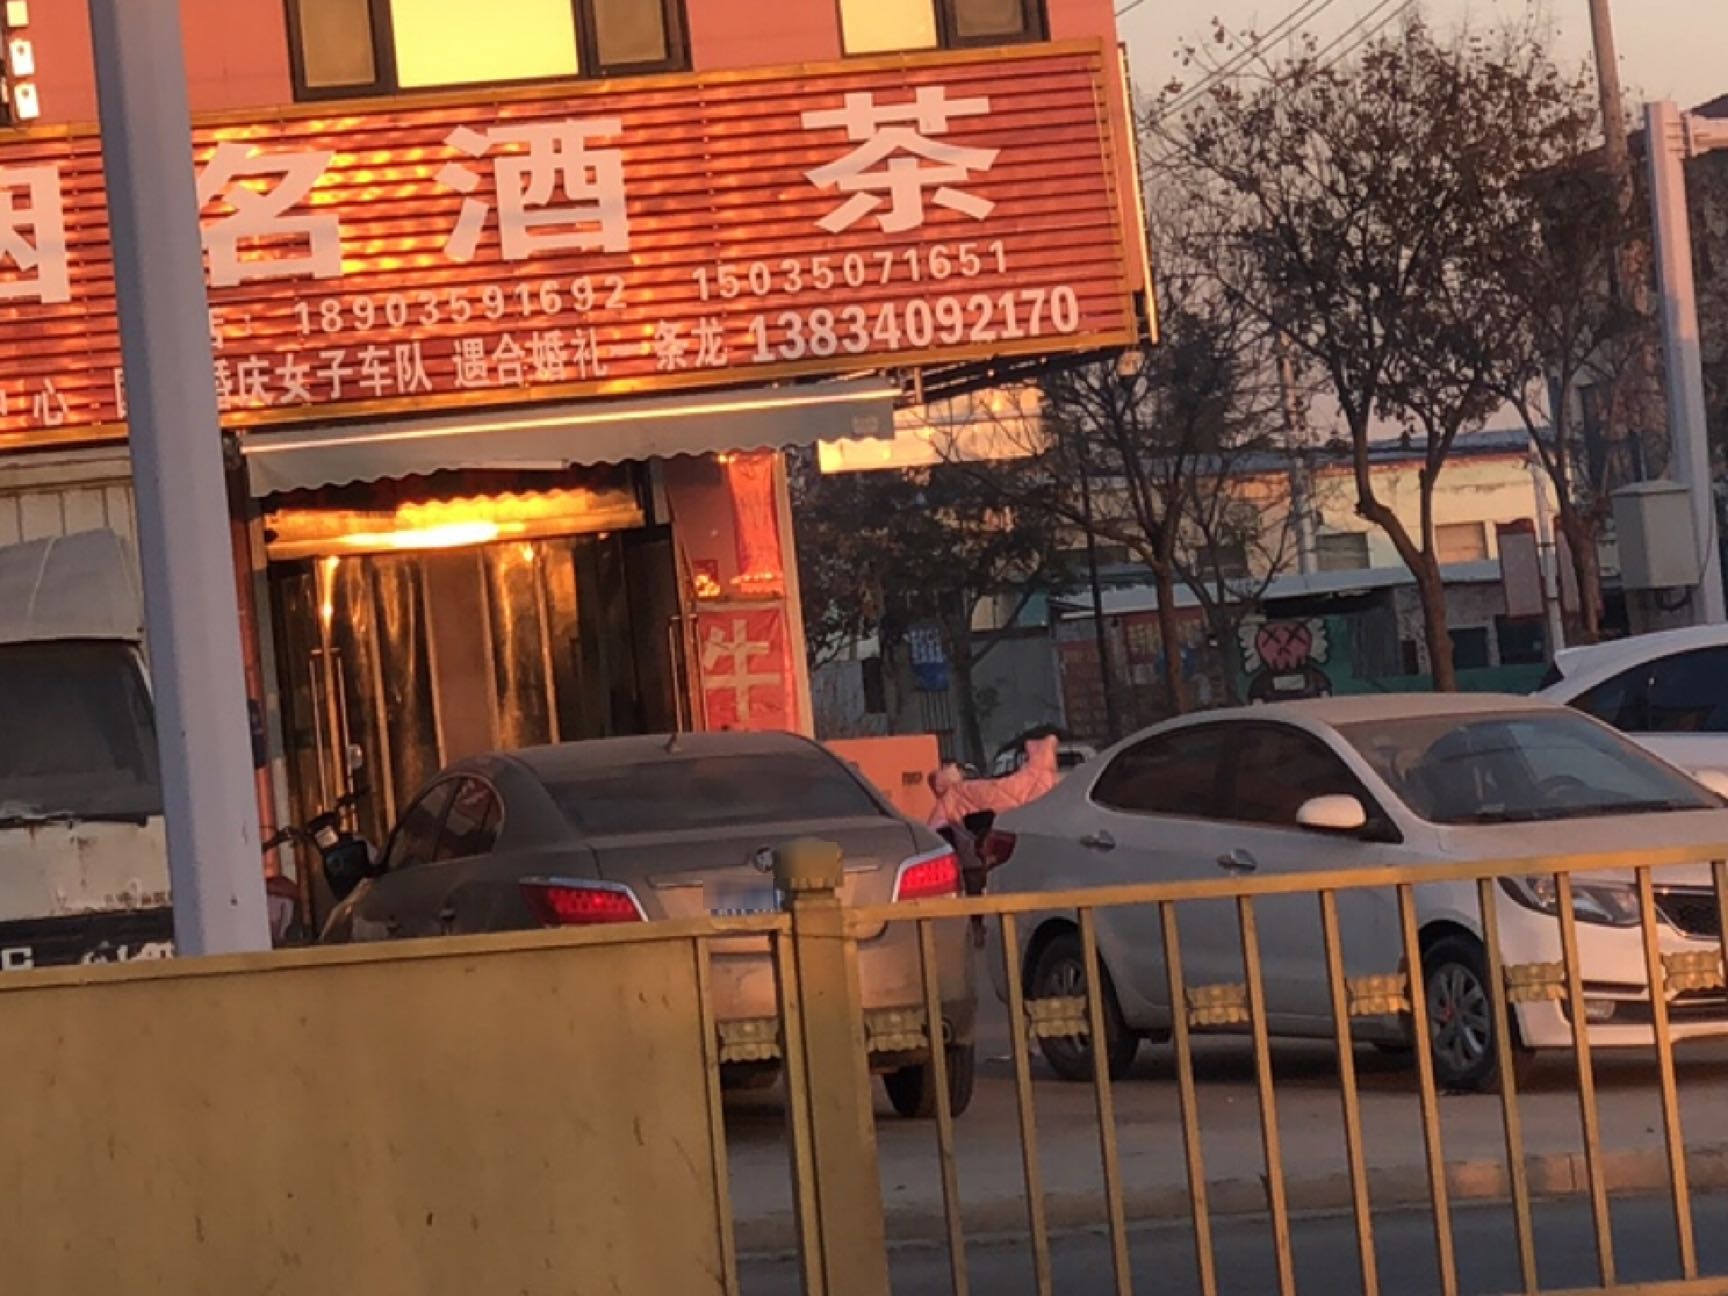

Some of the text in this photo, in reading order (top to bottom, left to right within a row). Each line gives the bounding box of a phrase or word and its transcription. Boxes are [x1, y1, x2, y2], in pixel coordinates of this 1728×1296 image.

[294, 275, 629, 335] 18903591692
[692, 240, 1008, 301] 15035071651
[749, 285, 1080, 364] 13834092170
